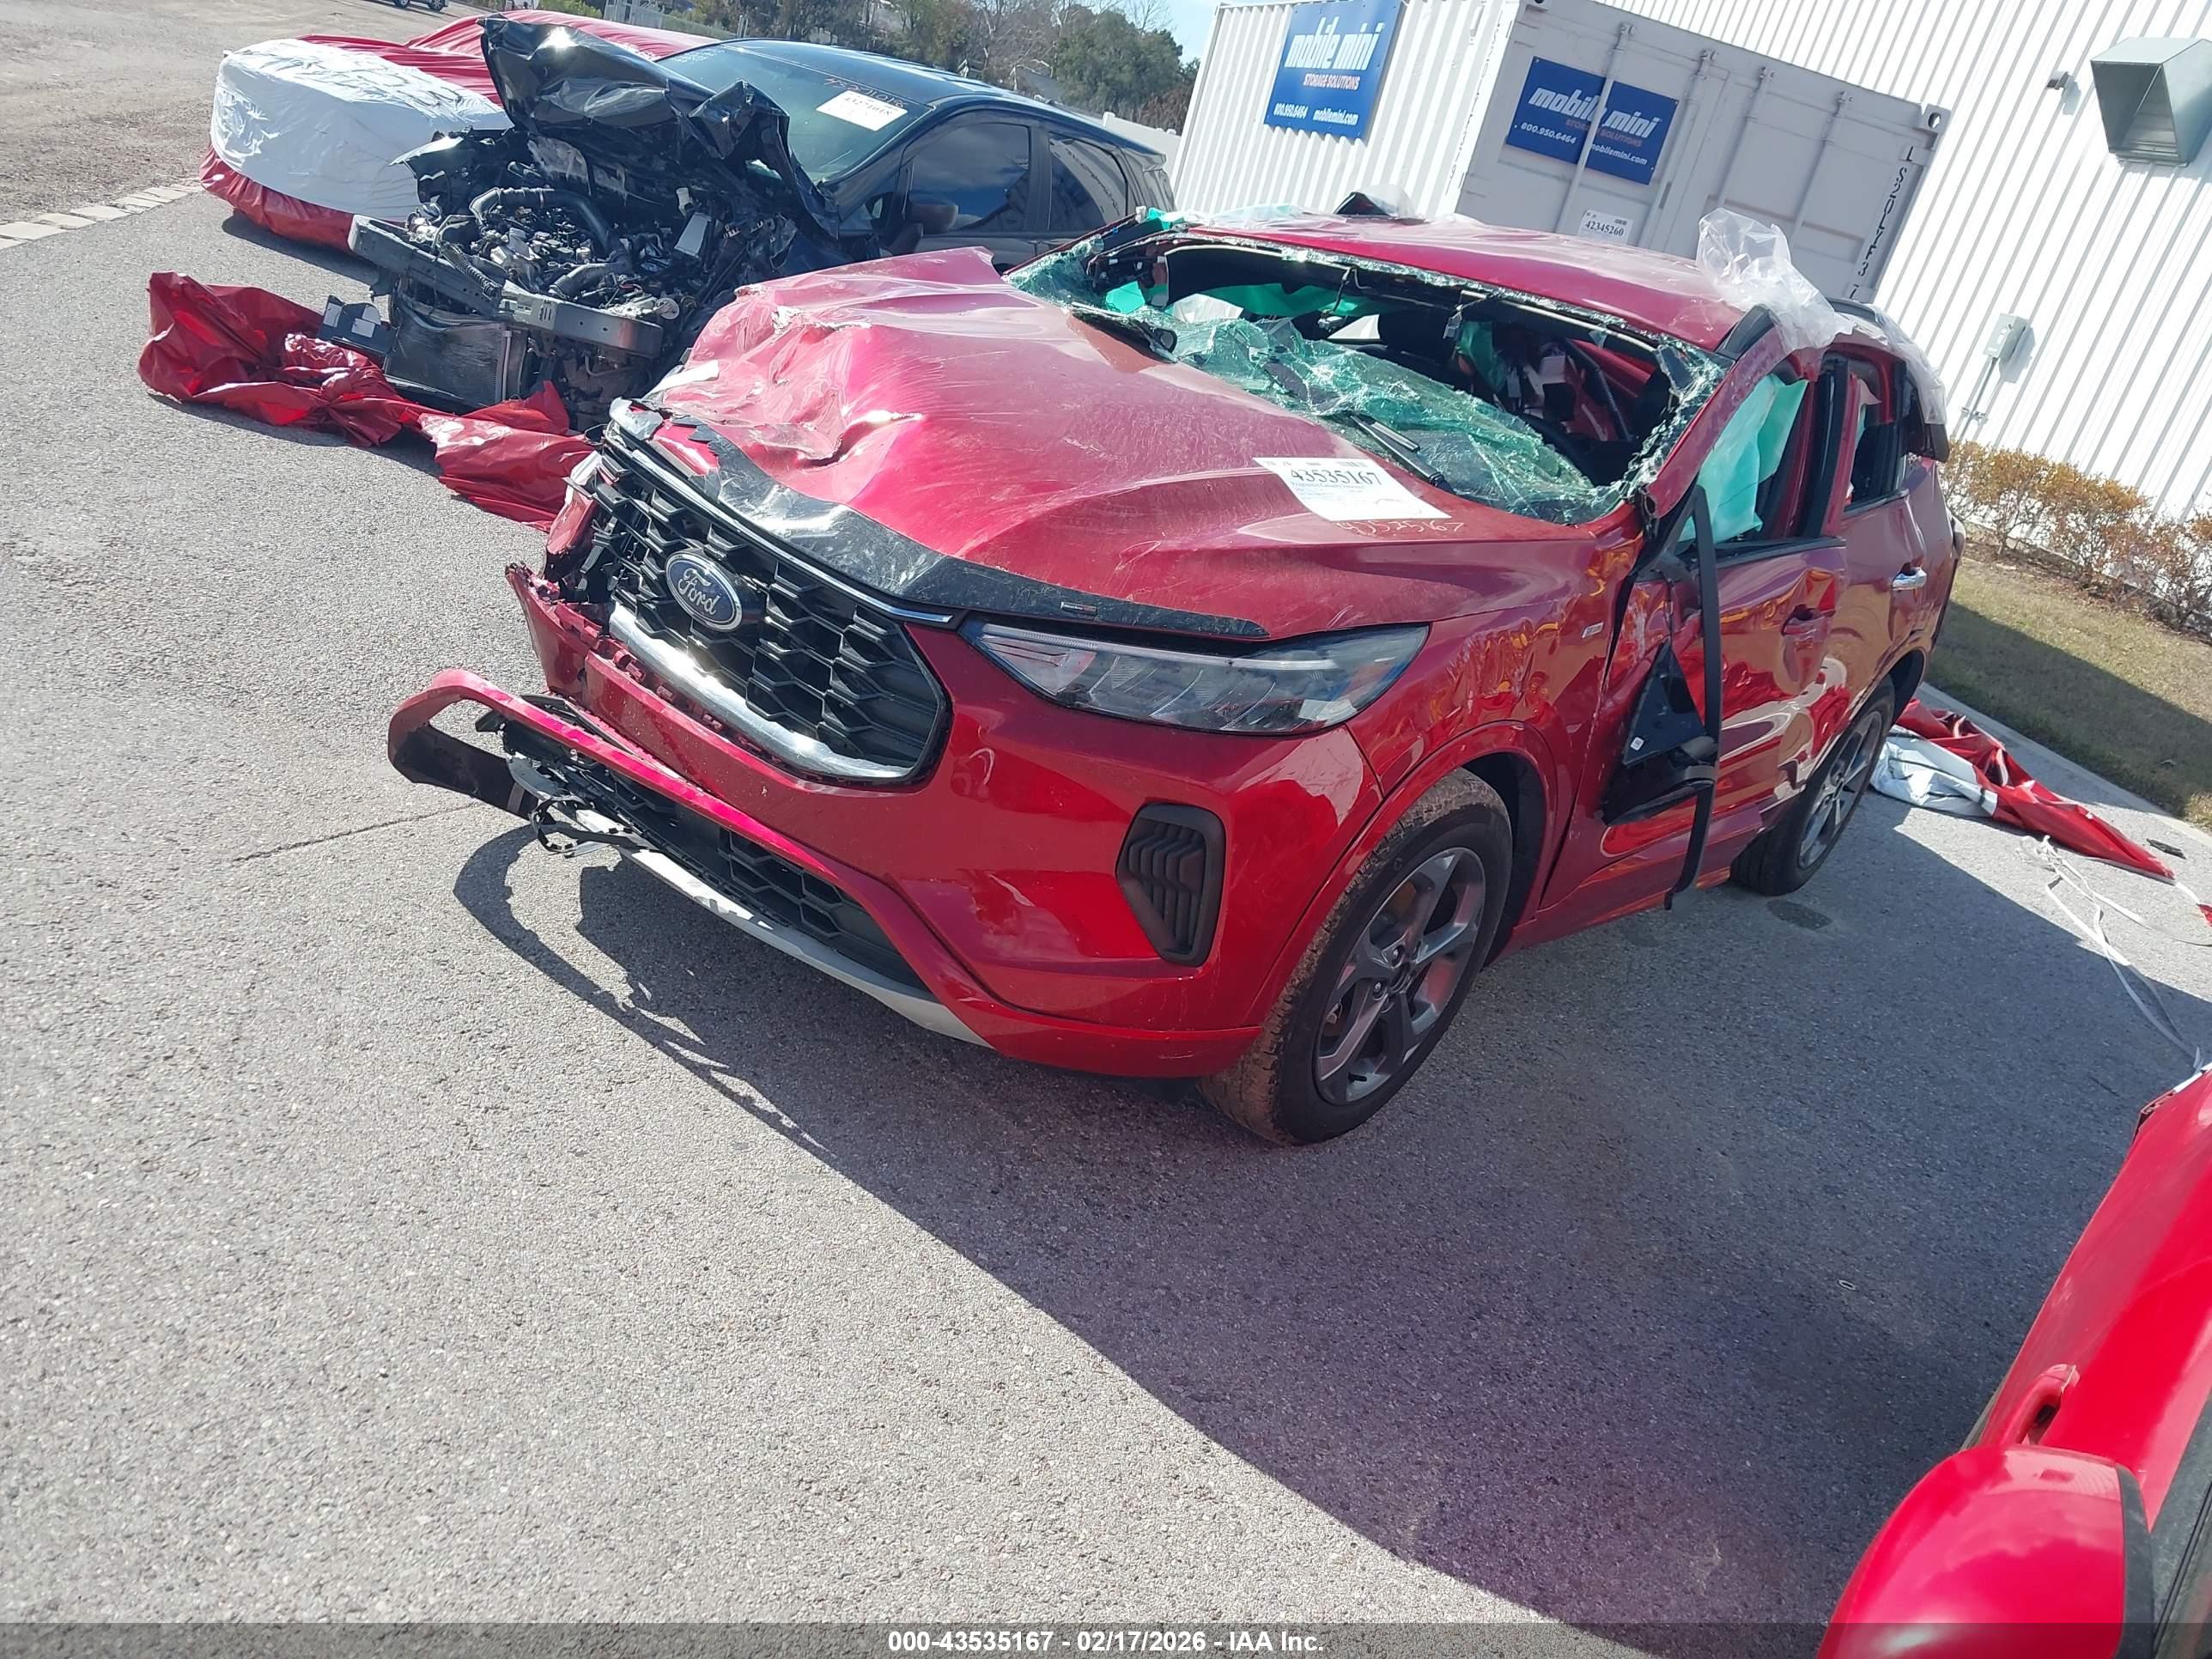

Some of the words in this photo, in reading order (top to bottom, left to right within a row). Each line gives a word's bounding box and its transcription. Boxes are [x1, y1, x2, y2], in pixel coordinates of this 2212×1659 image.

[1284, 15, 1341, 69] mobile
[1332, 22, 1385, 70] mini
[1303, 73, 1329, 88] STORAGE
[1327, 75, 1361, 91] SOLUTIONS
[1312, 108, 1359, 126] mobilemini.com
[1601, 110, 1658, 138] mini
[1521, 122, 1577, 145] 800.950.6464
[1566, 118, 1600, 136] STOR
[1585, 220, 1625, 237] 42345260
[1291, 469, 1382, 485] 43535167
[678, 568, 721, 615] Ford
